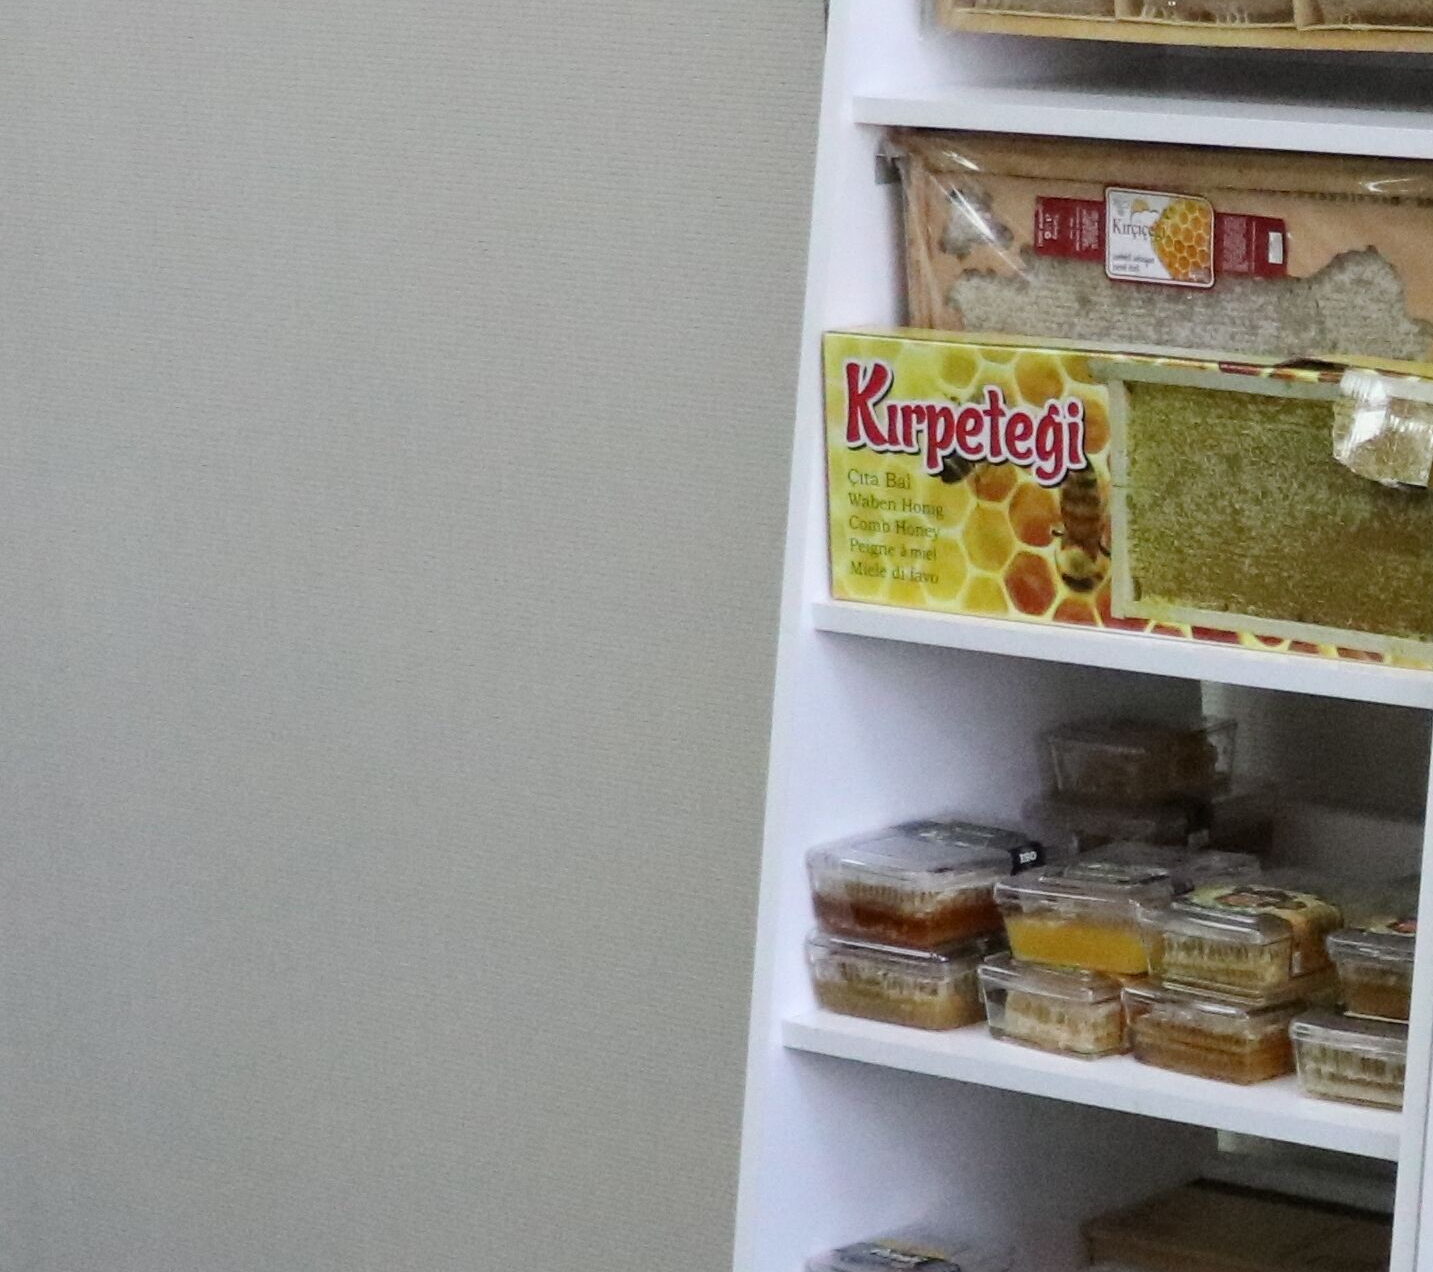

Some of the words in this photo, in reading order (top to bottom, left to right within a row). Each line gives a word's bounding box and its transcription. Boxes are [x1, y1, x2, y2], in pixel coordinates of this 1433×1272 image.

[847, 492, 898, 512] Waben
[902, 495, 945, 518] Honig
[848, 516, 891, 532] Comb
[895, 519, 941, 540] Honey
[849, 538, 897, 558] Peigne
[909, 544, 938, 561] miel
[850, 560, 887, 578] Miele
[891, 563, 906, 581] di
